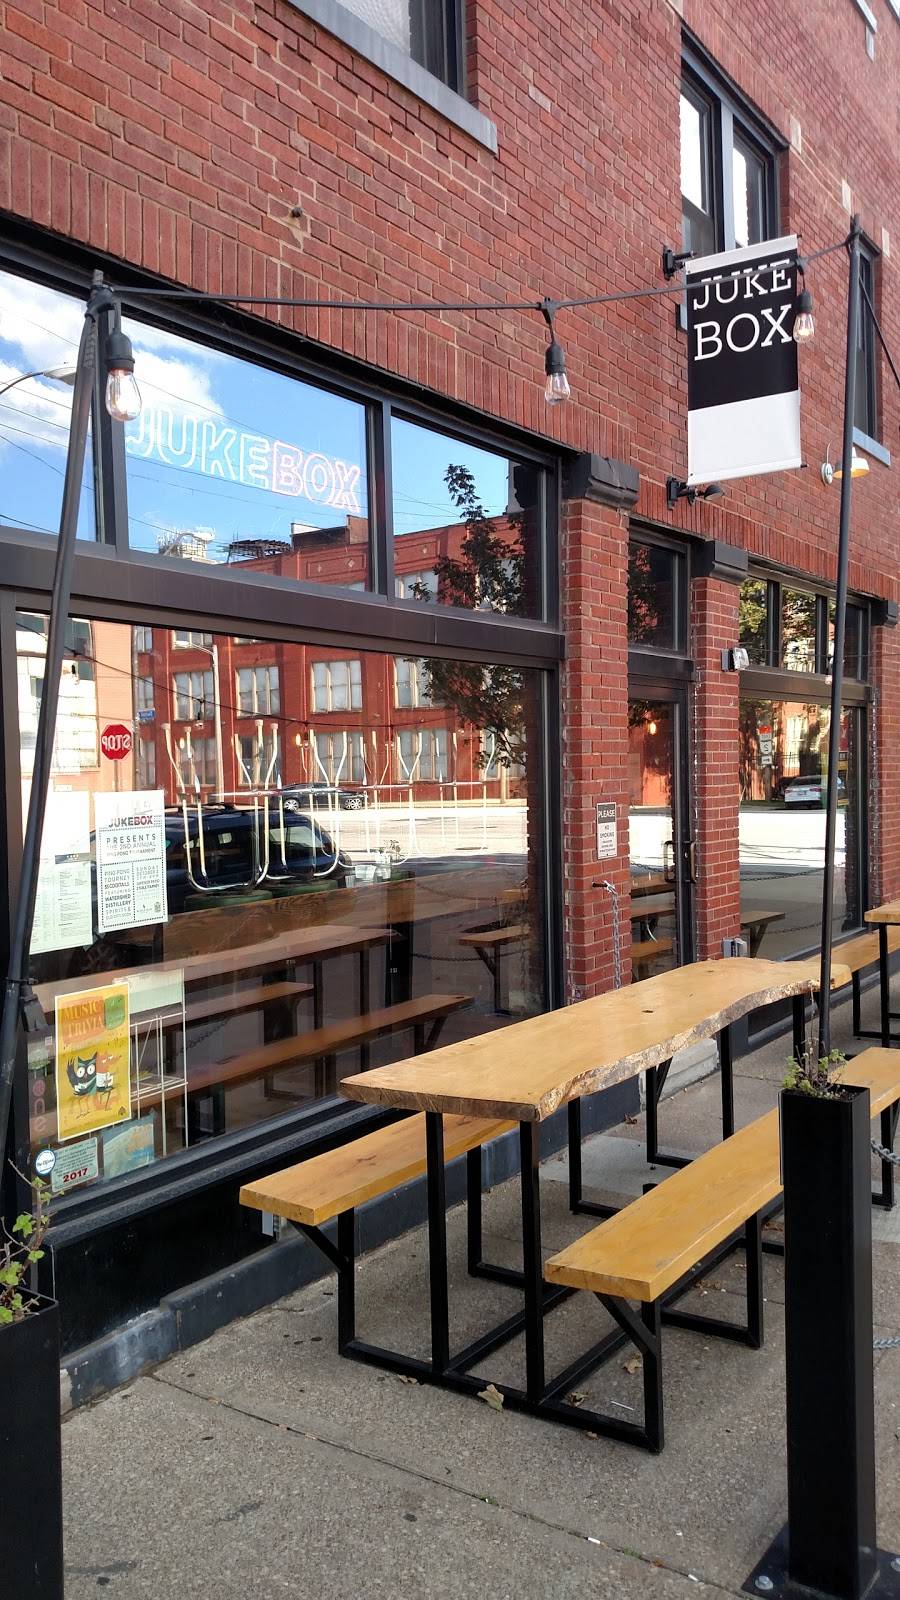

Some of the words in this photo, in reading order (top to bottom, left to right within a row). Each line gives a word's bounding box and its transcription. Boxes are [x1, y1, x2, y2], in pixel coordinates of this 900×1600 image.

[693, 258, 792, 311] JUKE
[693, 303, 793, 361] BOX
[125, 407, 361, 514] JUKEBOX
[598, 809, 616, 818] PLEASE
[108, 815, 153, 828] JUKEBOX
[106, 833, 156, 845] PRESENTS
[599, 831, 615, 839] SMOKING
[104, 875, 130, 883] TOURNEY
[105, 900, 131, 909] DISTILLERY
[63, 1000, 100, 1023] MUSIC
[66, 1015, 103, 1038] TRIVIA
[63, 1167, 88, 1183] 2017
